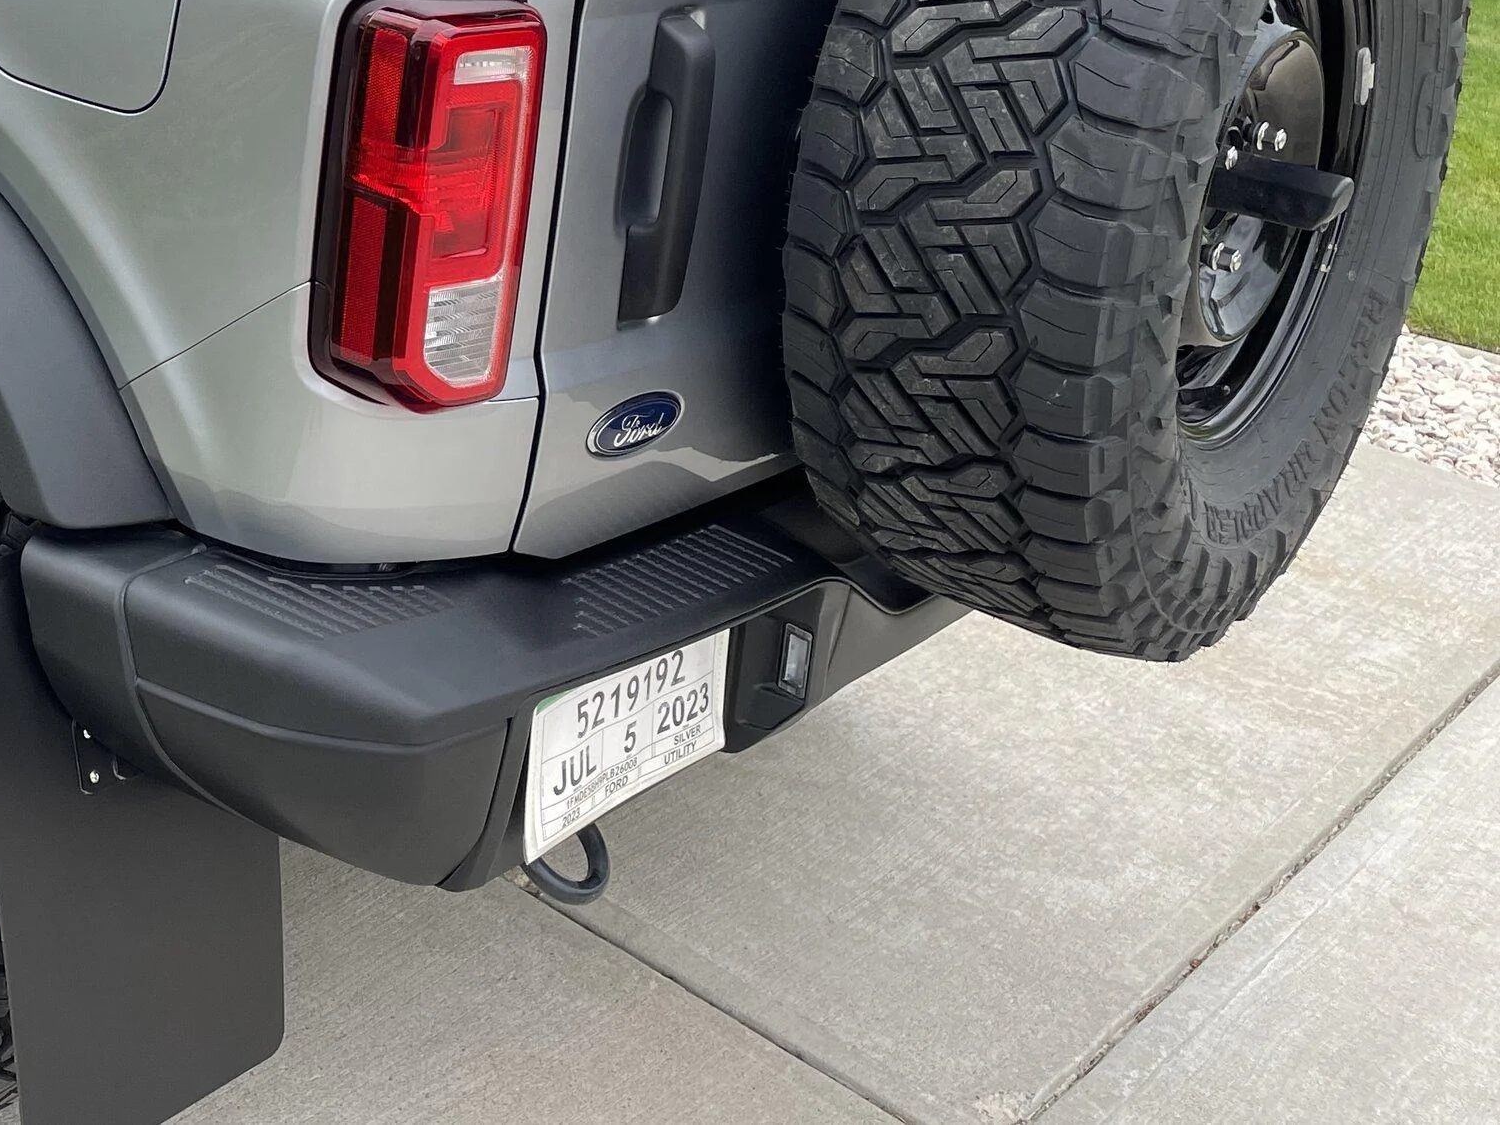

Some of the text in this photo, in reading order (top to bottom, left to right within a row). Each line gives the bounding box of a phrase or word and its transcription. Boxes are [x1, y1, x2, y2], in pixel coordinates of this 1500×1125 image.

[613, 411, 671, 448] Ford
[577, 649, 686, 739] 5219192
[553, 682, 709, 796] JUL 5 2023
[674, 724, 702, 746] SILVER
[605, 775, 629, 798] FORD
[664, 740, 697, 765] UTILITY
